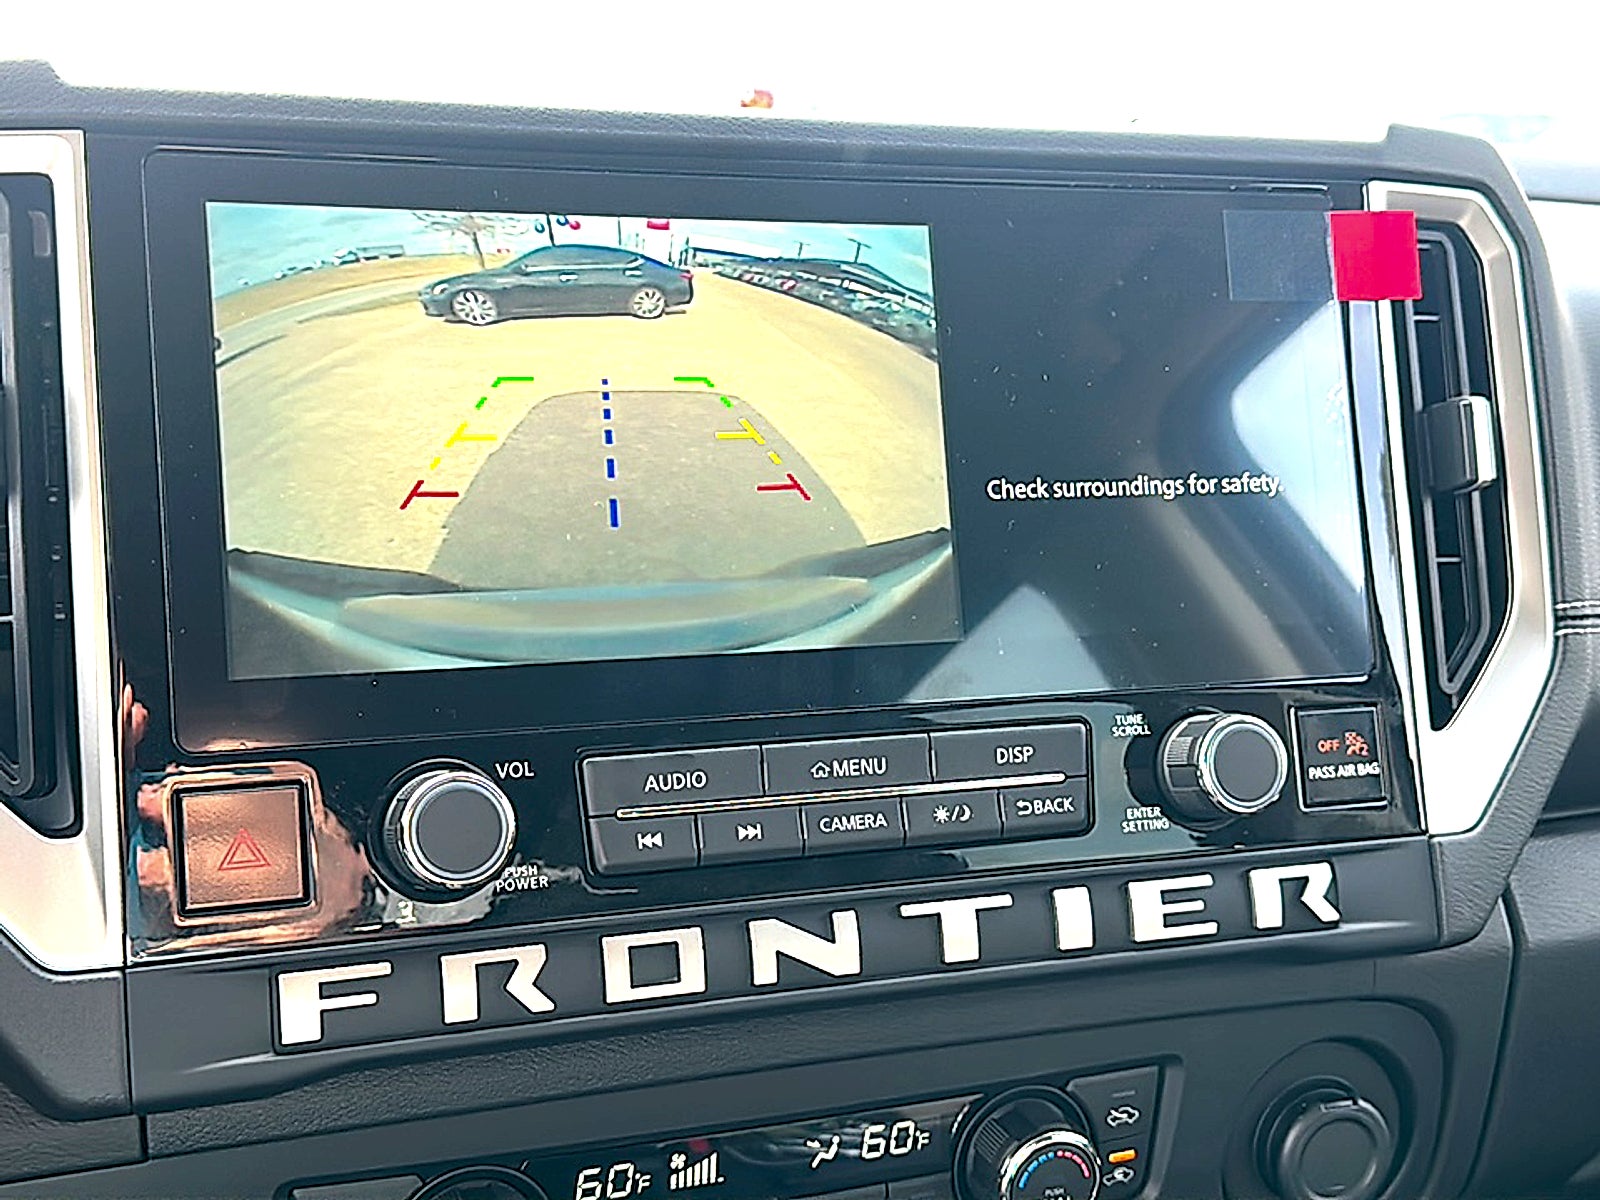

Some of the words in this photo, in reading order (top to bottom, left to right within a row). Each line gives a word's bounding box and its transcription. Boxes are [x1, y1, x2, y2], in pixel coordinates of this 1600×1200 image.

[986, 476, 1050, 500] Check
[1053, 474, 1184, 500] surroundings
[1187, 472, 1218, 495] for
[1221, 471, 1284, 498] safety.
[1115, 714, 1143, 726] TUNE
[1112, 725, 1151, 737] SCROLL
[996, 746, 1035, 765] DISP
[1318, 739, 1341, 753] OFF
[495, 761, 535, 780] VOL
[832, 756, 888, 778] MENU
[1308, 765, 1336, 780] PASS
[1337, 763, 1357, 777] AIR
[1357, 761, 1380, 776] BAG
[643, 771, 707, 793] AUDIO
[1034, 795, 1074, 814] BACK
[1126, 806, 1161, 820] ENTER
[819, 812, 888, 833] CAMERA
[1121, 818, 1169, 833] SETTING
[504, 865, 538, 877] PUSH
[495, 876, 549, 892] POWER
[278, 862, 1340, 1047] FRONTIER
